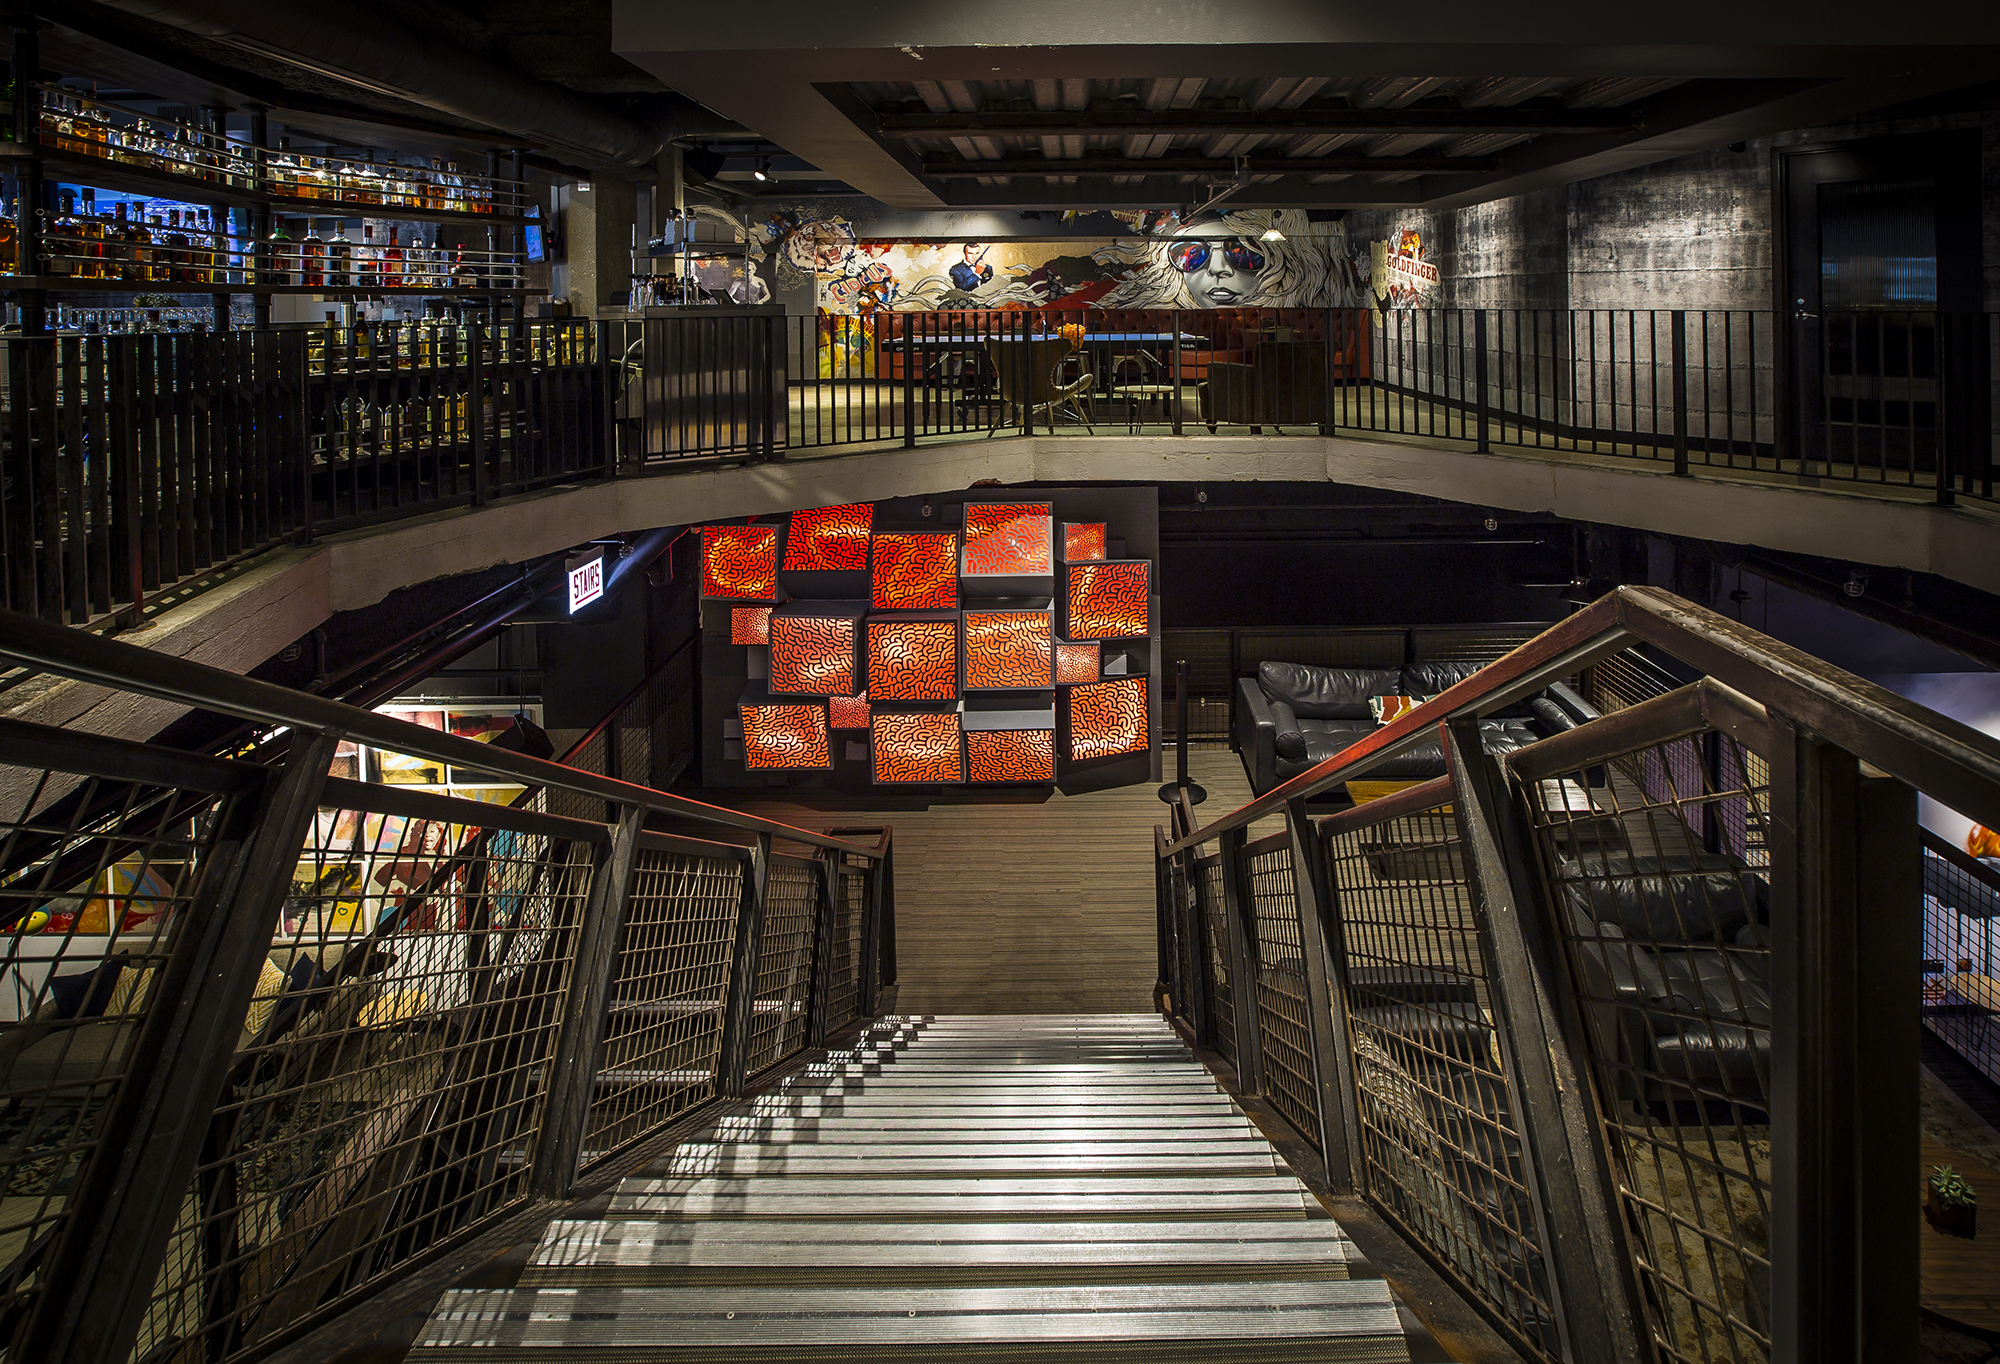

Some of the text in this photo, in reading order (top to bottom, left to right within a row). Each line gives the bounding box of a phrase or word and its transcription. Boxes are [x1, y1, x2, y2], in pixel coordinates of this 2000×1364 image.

[828, 262, 892, 303] CIRCUS
[1387, 255, 1438, 282] GOLDFINGER
[574, 563, 600, 599] STAIRS
